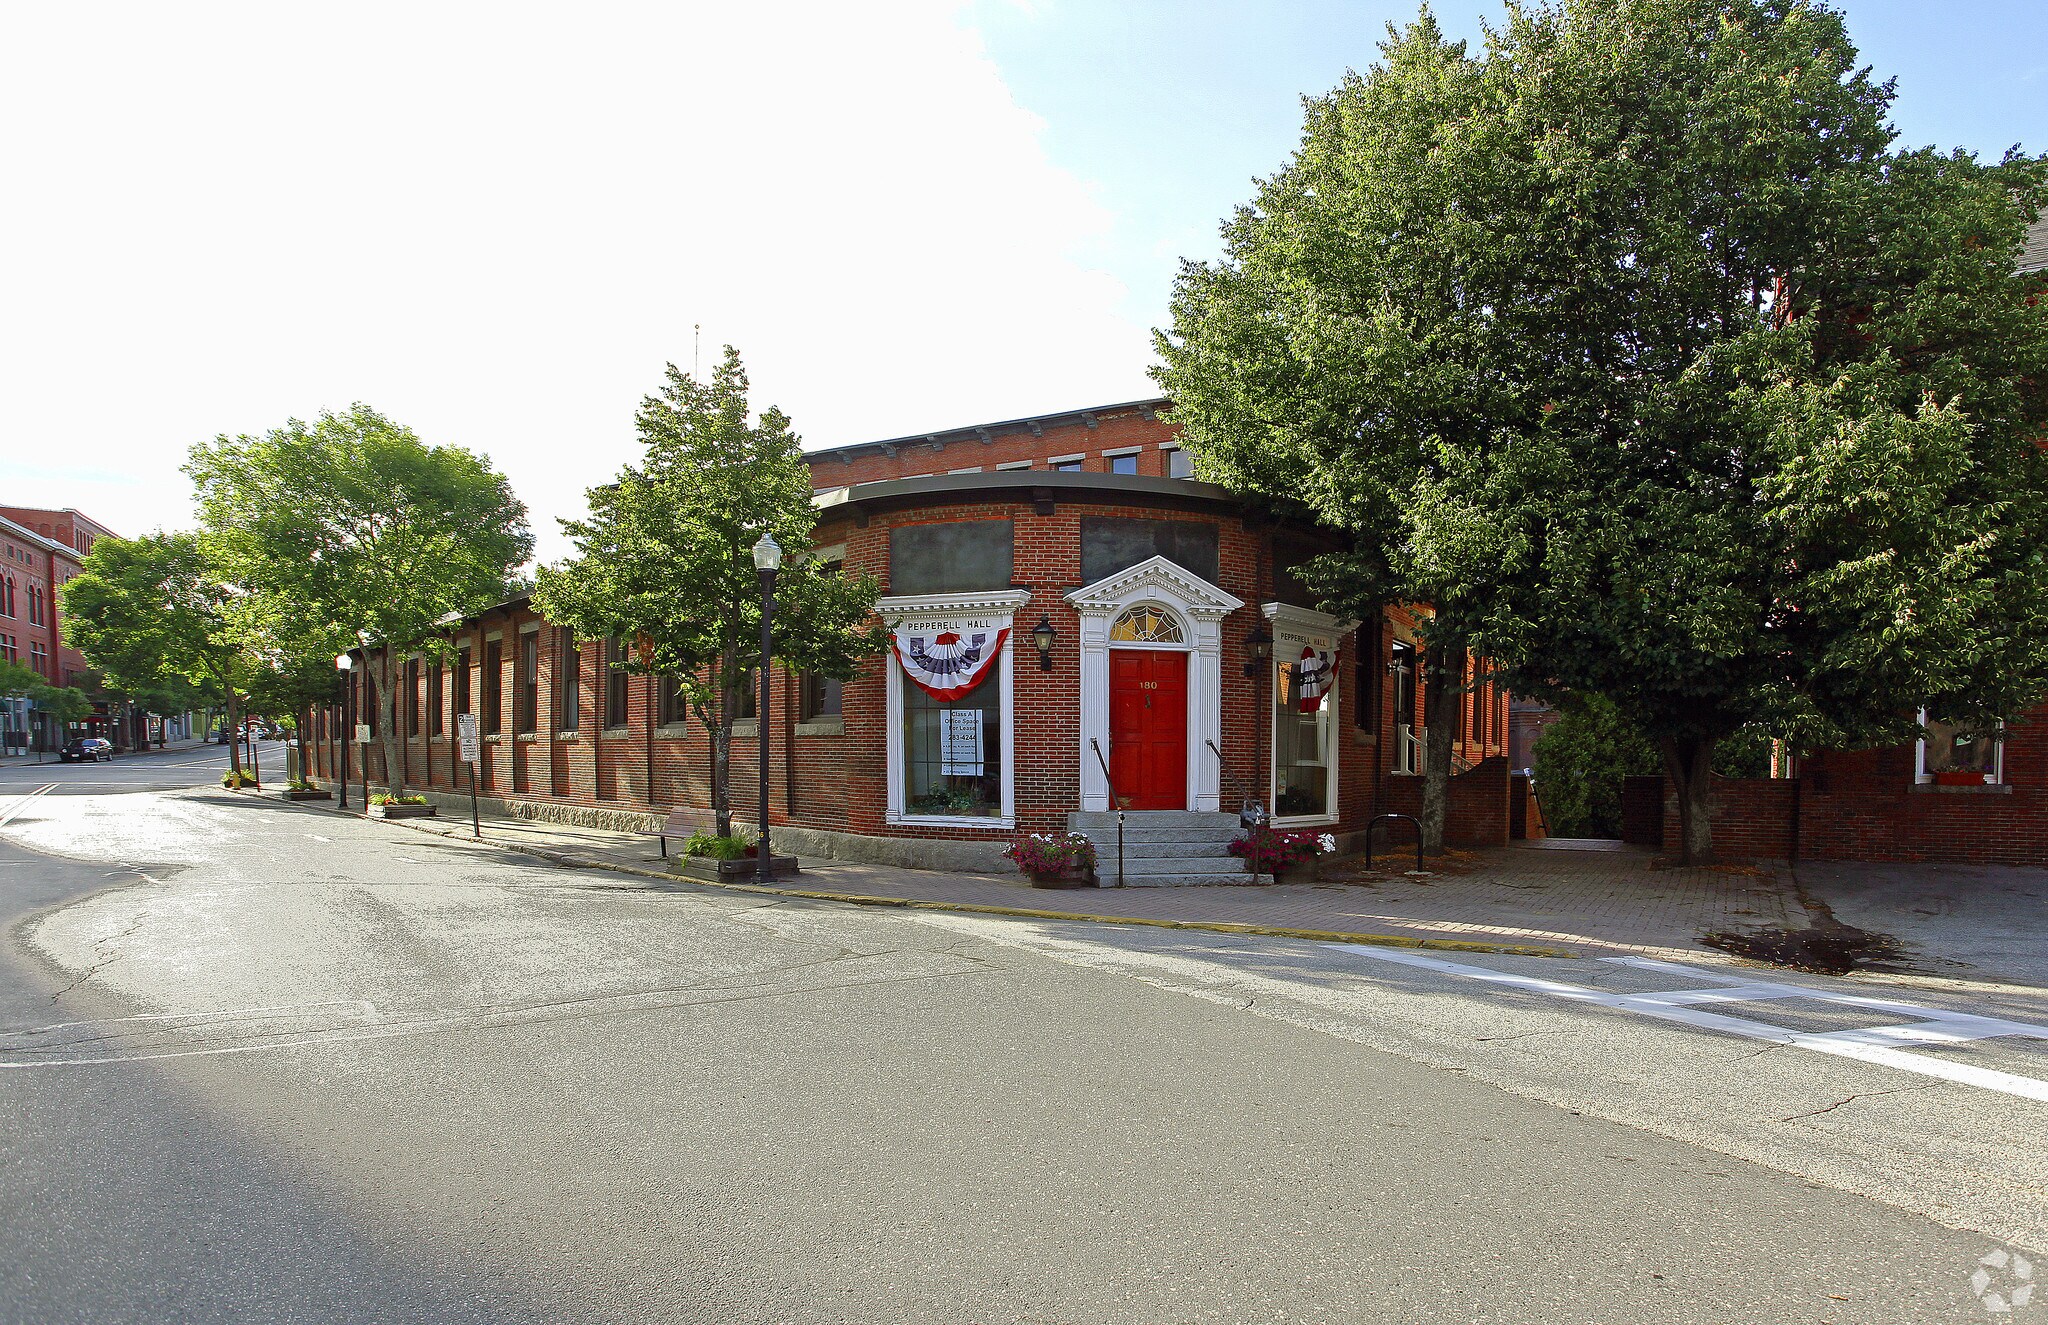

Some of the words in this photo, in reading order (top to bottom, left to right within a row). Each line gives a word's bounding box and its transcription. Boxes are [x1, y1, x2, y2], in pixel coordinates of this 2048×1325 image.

[907, 621, 961, 631] PEPPERELL
[967, 620, 991, 628] HALL
[1280, 632, 1311, 644] PEPPERELL
[1138, 681, 1158, 690] 180
